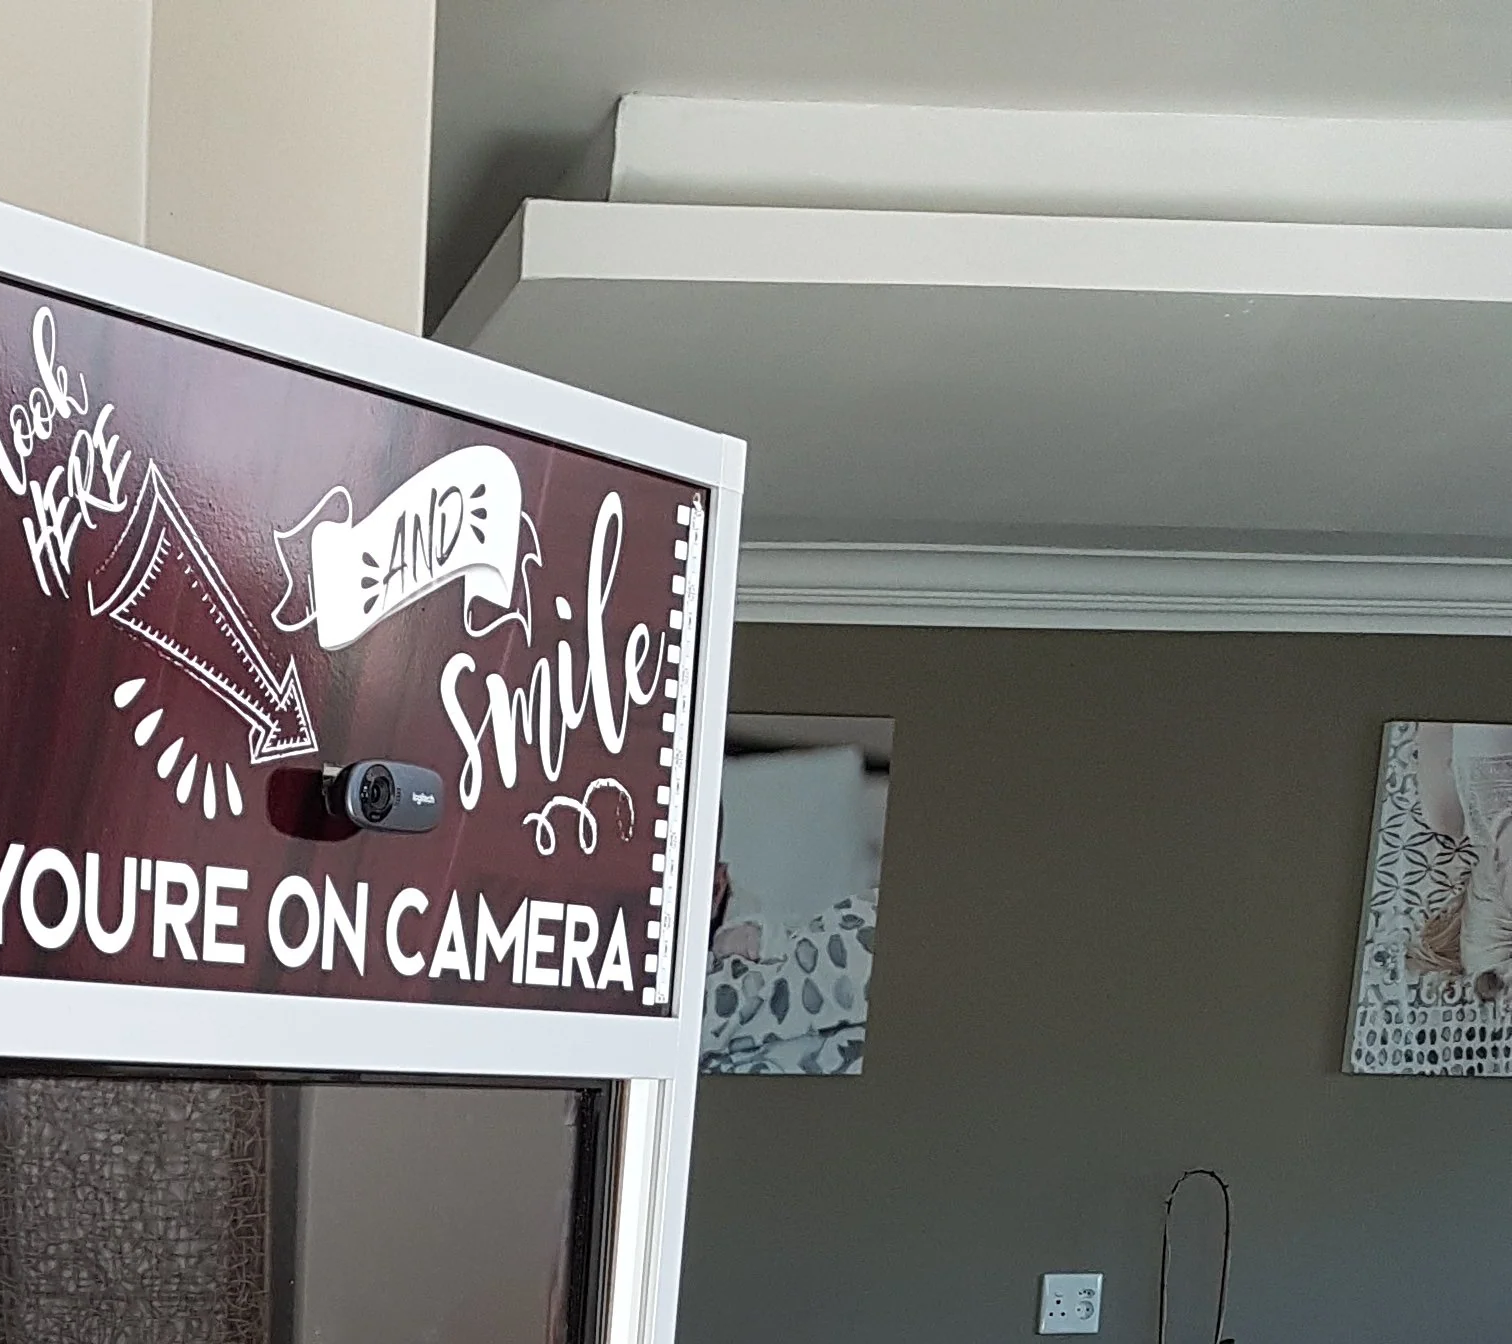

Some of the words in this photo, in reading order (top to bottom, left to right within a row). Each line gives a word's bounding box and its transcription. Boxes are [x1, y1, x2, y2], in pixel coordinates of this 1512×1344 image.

[23, 404, 132, 599] HERE
[383, 486, 463, 610] AND
[440, 491, 665, 811] smile
[267, 875, 369, 977] ON
[386, 888, 635, 992] CAMERA
